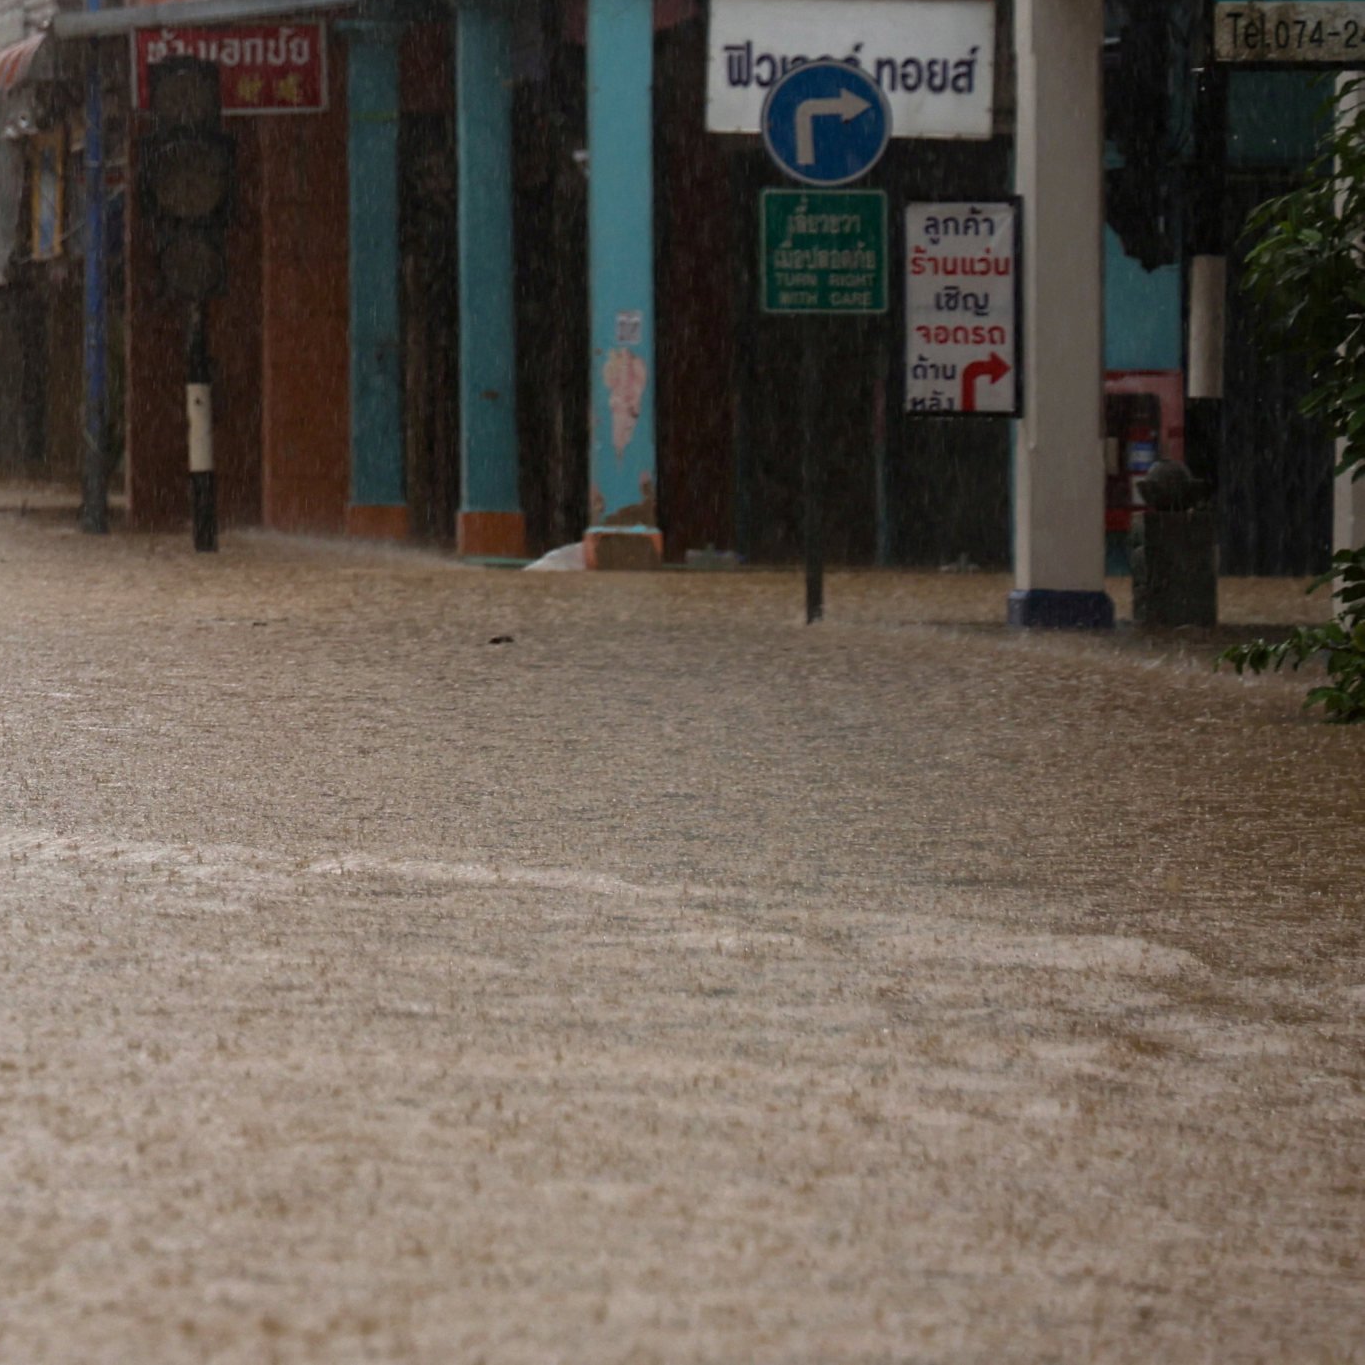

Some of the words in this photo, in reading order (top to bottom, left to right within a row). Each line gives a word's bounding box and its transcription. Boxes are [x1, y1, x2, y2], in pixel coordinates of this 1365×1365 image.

[875, 46, 980, 95] ทอยส์
[924, 206, 995, 245] ลูกค้า
[910, 246, 1010, 276] ร้านแว่น
[775, 273, 817, 287] TURN
[828, 273, 875, 288] RIGHT
[830, 292, 874, 306] CARE
[934, 286, 989, 317] เชิญ
[915, 324, 1006, 345] จอดรถ
[911, 354, 957, 381] ด้าน
